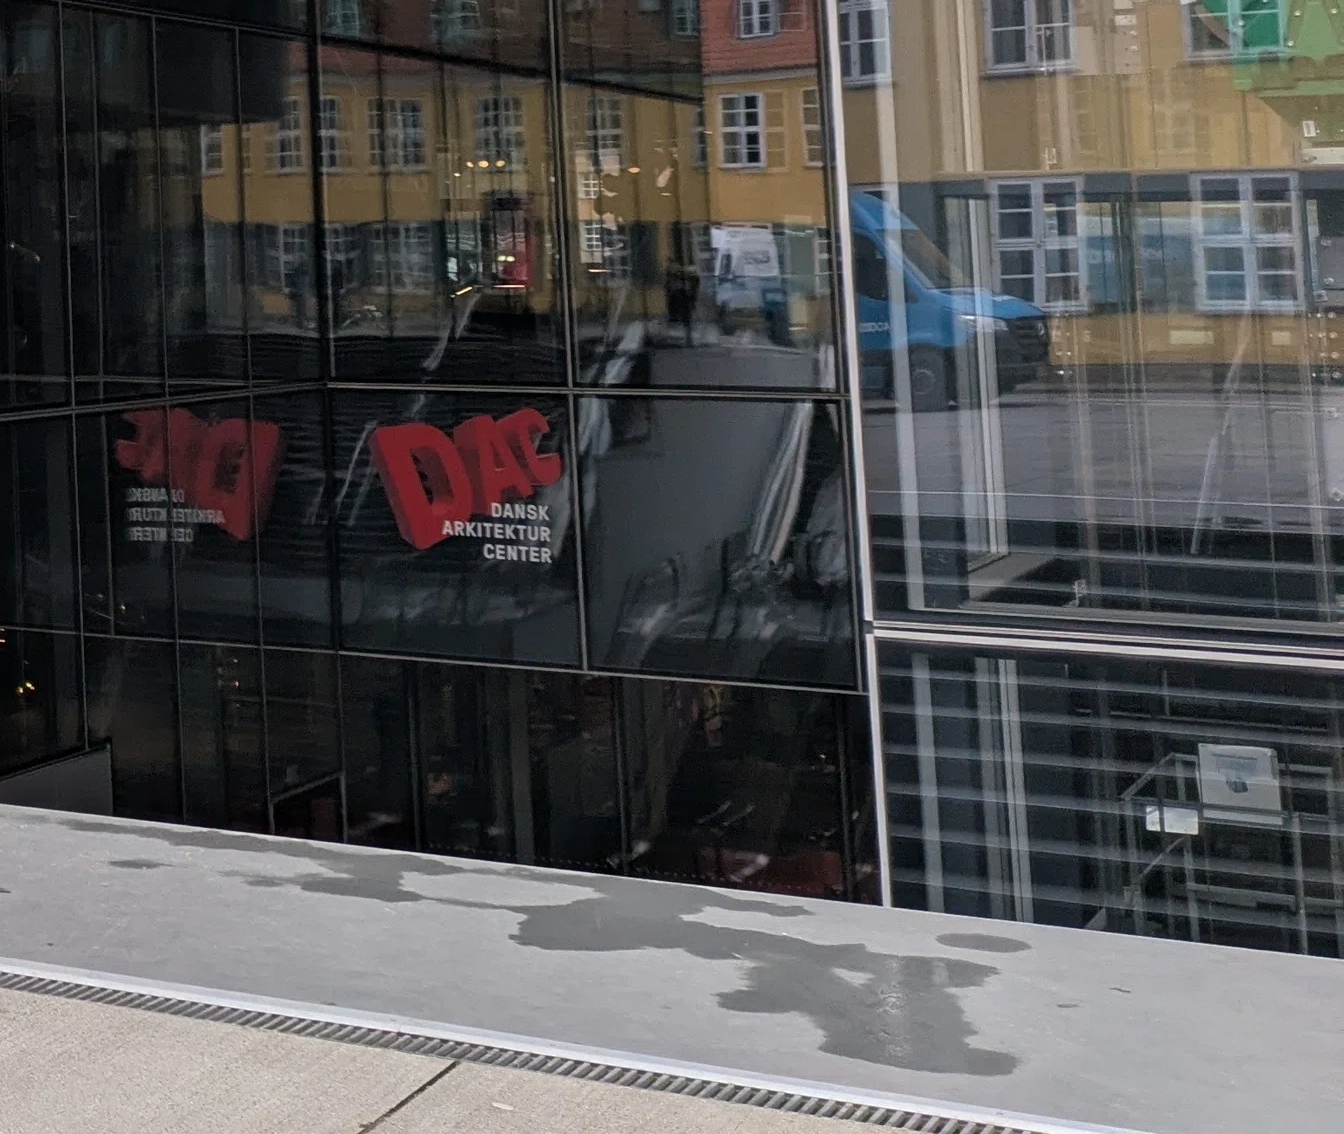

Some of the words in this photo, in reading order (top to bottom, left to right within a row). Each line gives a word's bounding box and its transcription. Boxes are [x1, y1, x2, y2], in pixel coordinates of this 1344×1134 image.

[367, 407, 562, 550] DAC
[491, 502, 551, 521] DANSK
[441, 520, 551, 542] ARKITEKTUR
[483, 543, 552, 564] CENTER
